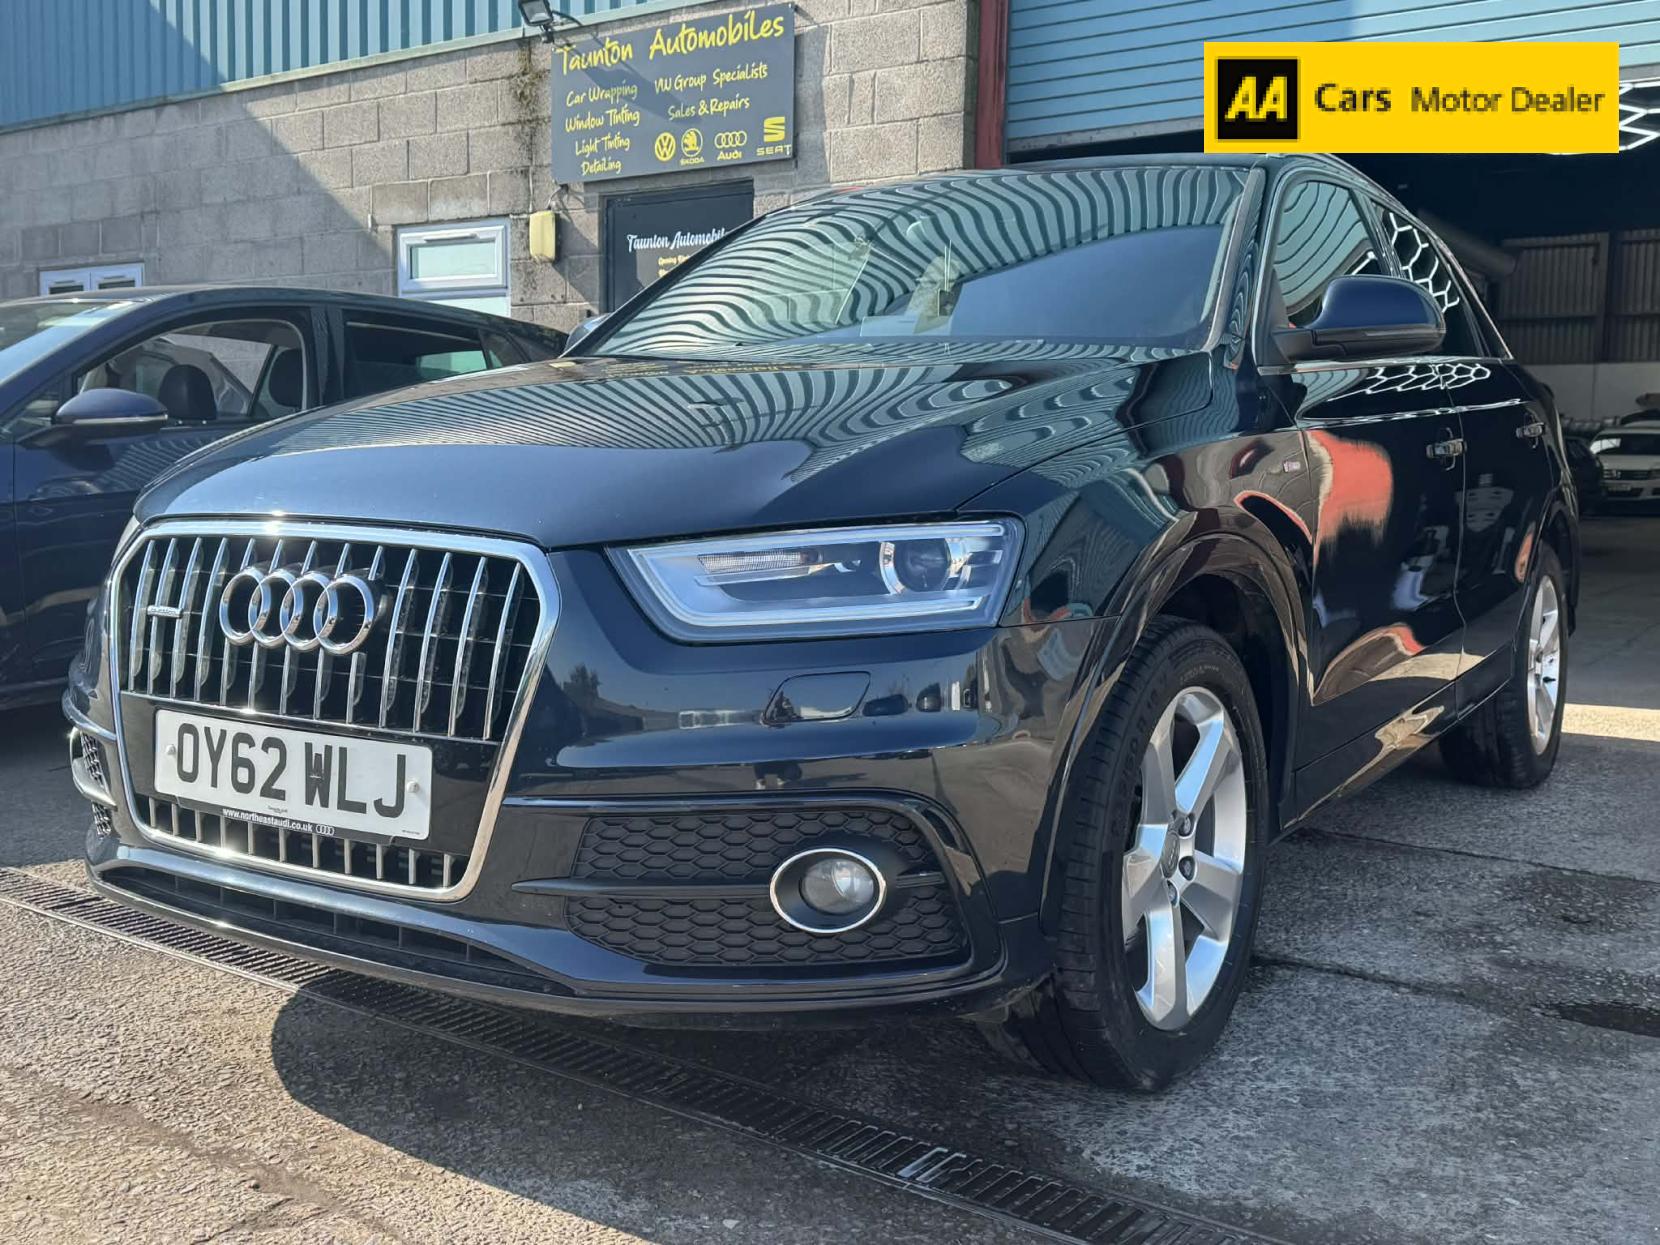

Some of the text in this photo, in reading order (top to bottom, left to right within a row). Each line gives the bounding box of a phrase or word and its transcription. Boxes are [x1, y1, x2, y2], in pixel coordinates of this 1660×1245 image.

[554, 10, 784, 75] Taunton Automobiles
[654, 62, 768, 95] VW Group Specialists
[566, 79, 638, 107] Car Wrapping
[667, 93, 750, 121] Sales & Repairs
[565, 103, 640, 133] Window Tinting
[575, 131, 630, 158] Light Tinting
[756, 144, 792, 157] SEAT
[581, 156, 622, 176] Detailing
[627, 227, 727, 253] Taunton Automobil
[176, 722, 407, 819] OY62 WLJ
[222, 807, 313, 833] www.northeastaudi.co.uk
